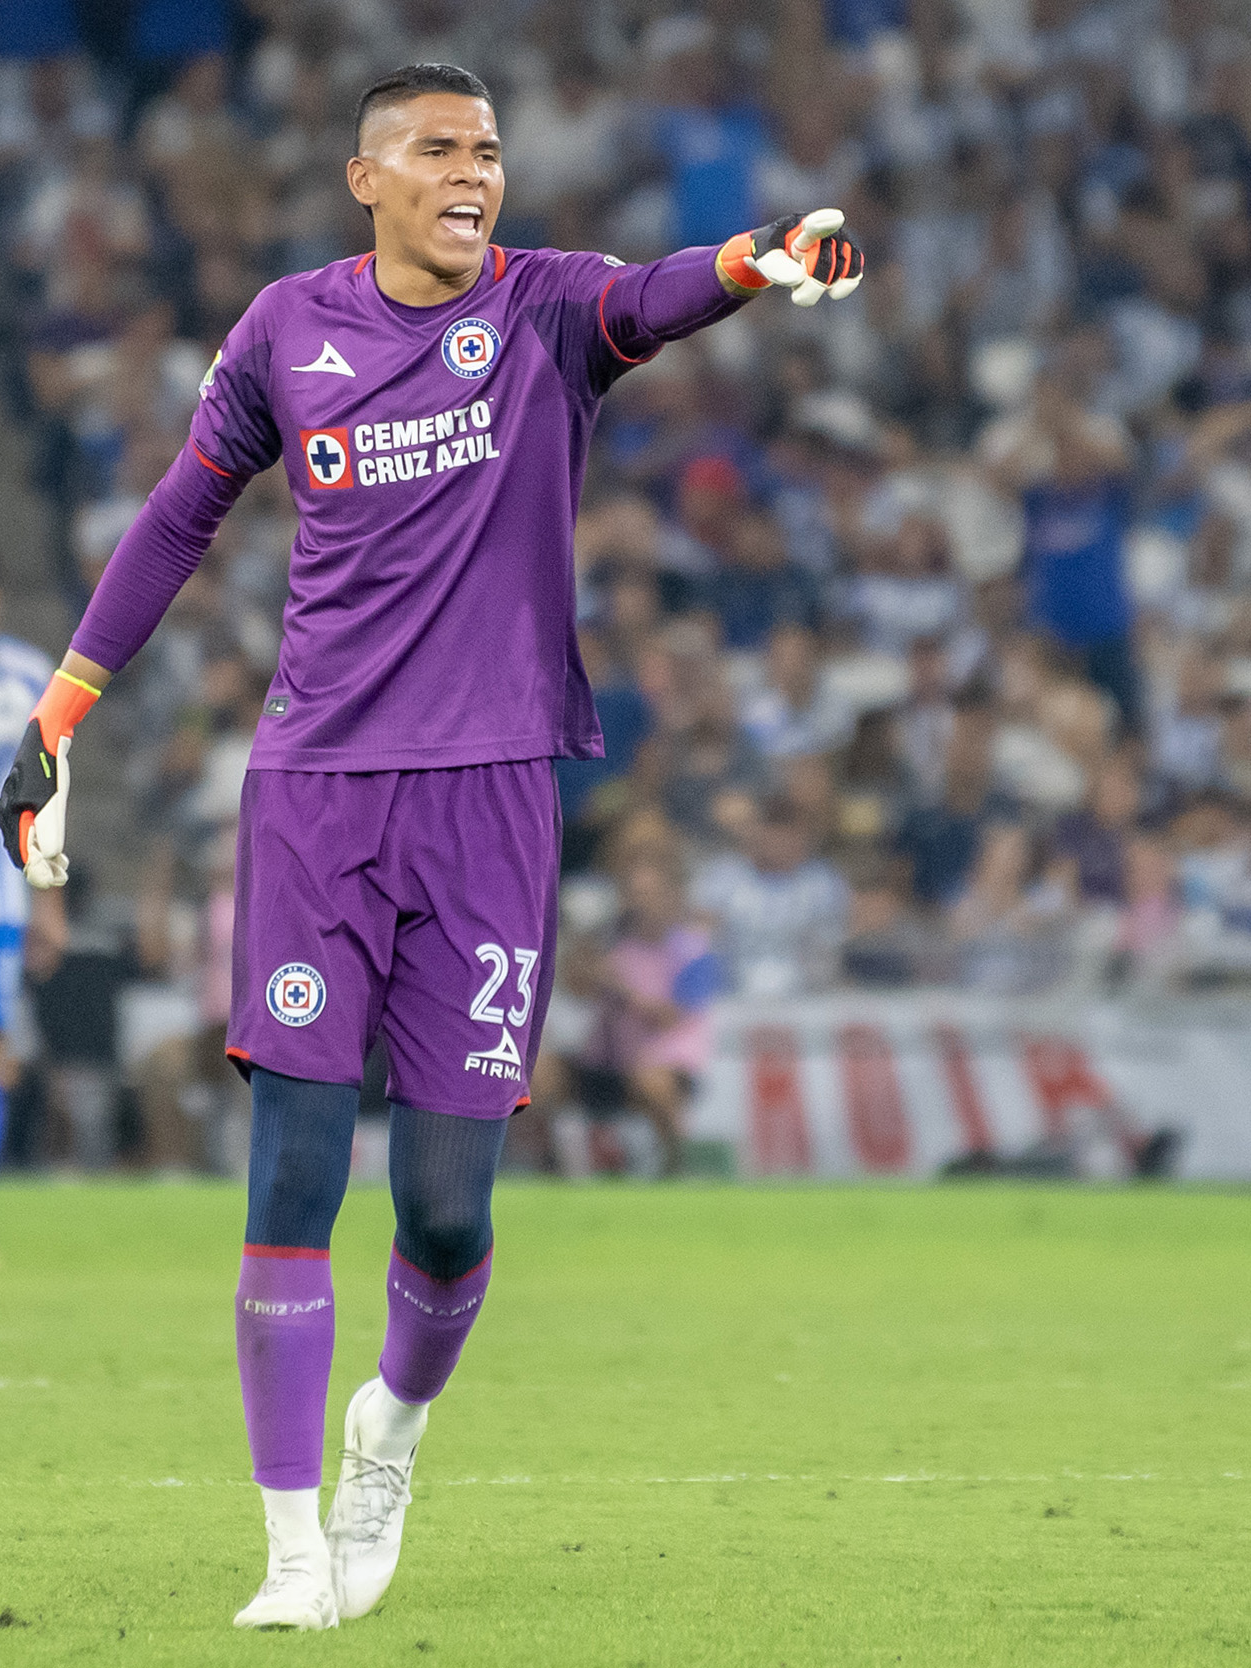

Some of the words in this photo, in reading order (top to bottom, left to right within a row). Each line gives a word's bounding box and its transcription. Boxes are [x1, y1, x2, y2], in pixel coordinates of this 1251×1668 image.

[354, 399, 491, 453] CEMENTO
[357, 449, 432, 487] CRUZ
[436, 432, 500, 473] AZUL
[469, 942, 539, 1028] 23
[464, 1056, 521, 1081] PIRMA
